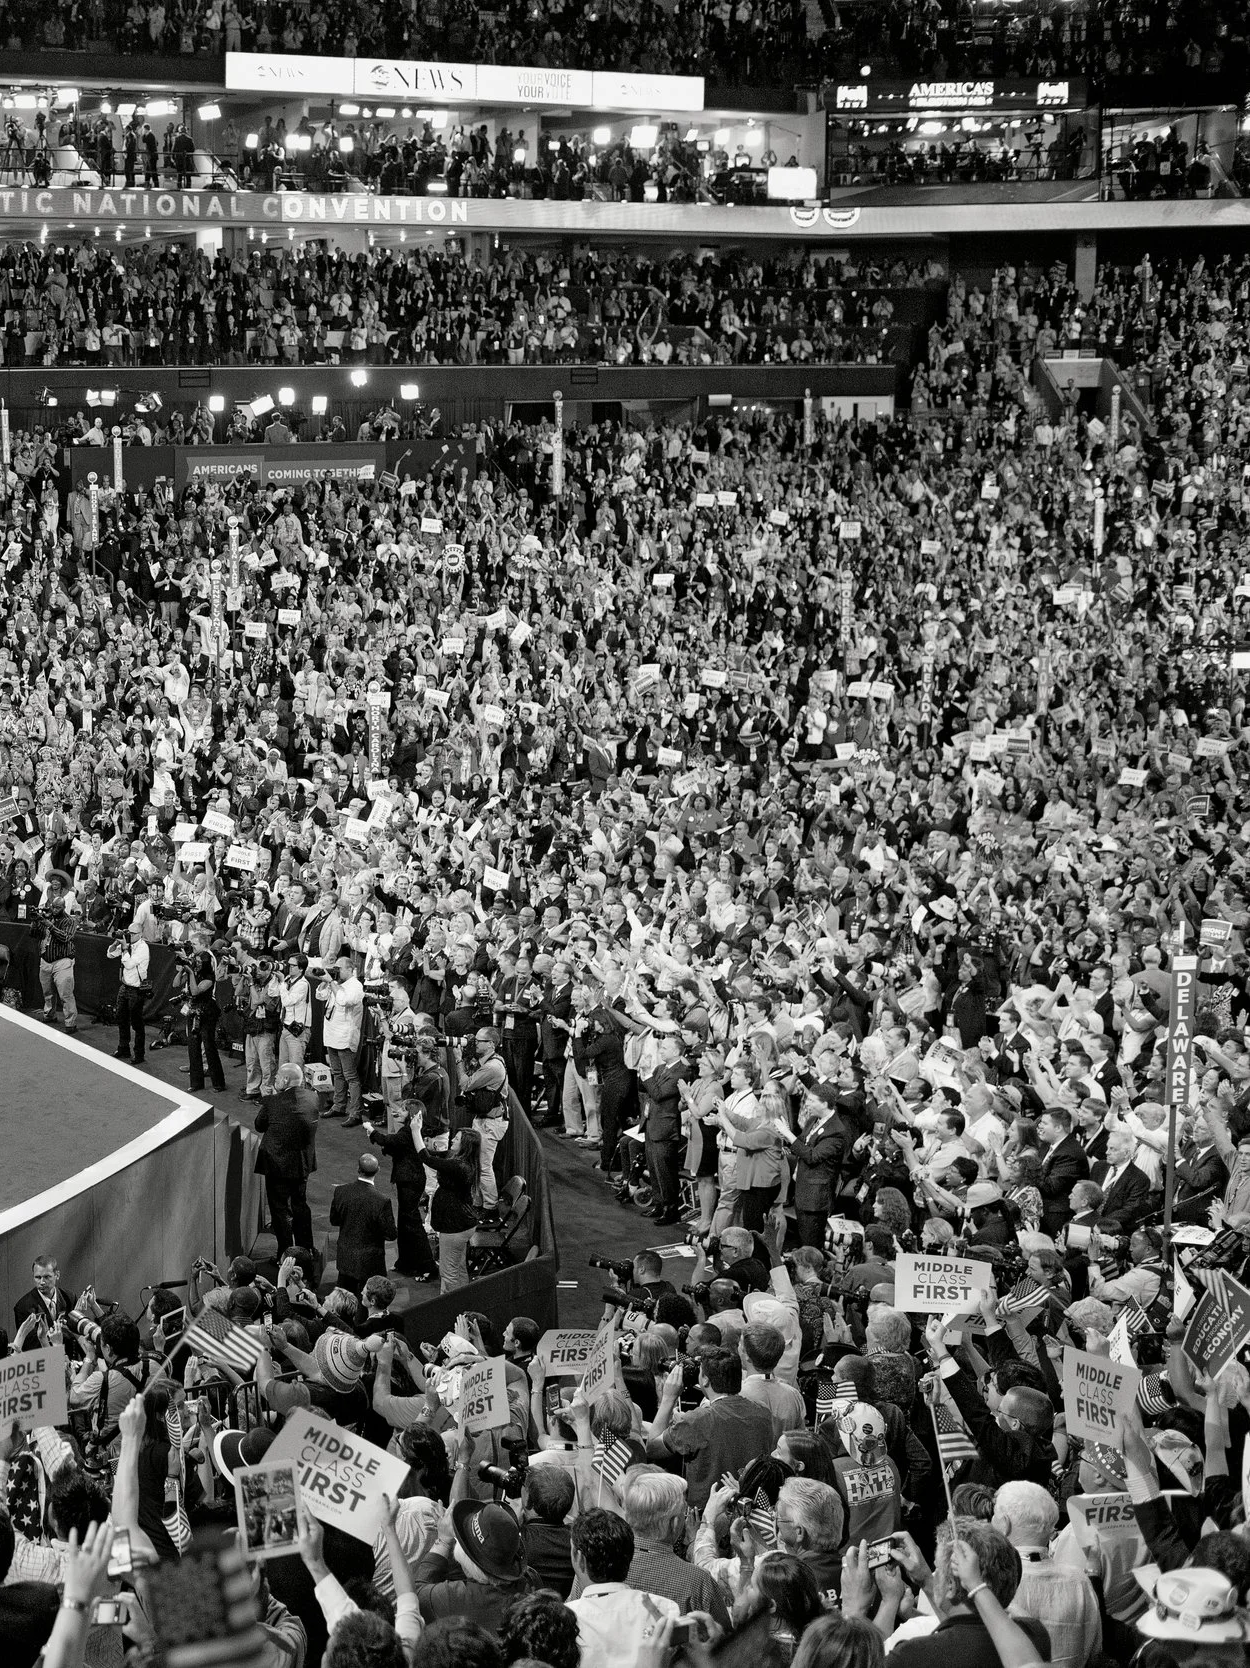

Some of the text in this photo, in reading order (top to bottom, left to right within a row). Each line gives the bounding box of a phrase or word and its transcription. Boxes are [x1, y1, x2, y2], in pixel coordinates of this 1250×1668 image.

[517, 85, 544, 99] YOUR
[544, 73, 572, 88] VOICE
[908, 82, 994, 97] AMERICA'S
[73, 192, 246, 217] NATIONAL
[263, 196, 469, 223] CONVENTION
[193, 463, 258, 475] AMERICANS
[267, 466, 359, 479] COMING TOGETH
[91, 514, 99, 542] ISLAND
[212, 580, 221, 637] PENNSYLVANIA
[841, 590, 851, 643] OREGON
[921, 663, 933, 723] NEVADA
[1038, 657, 1048, 714] IOWA
[370, 705, 380, 773] NORTH CAROLINA
[208, 819, 228, 830] FIRST
[377, 805, 388, 824] FIRST
[230, 857, 251, 866] FIRST
[487, 878, 503, 888] FIRST
[930, 1043, 941, 1057] MID
[1172, 971, 1192, 1104] DELAWARE
[941, 1048, 954, 1063] FIR
[913, 1261, 974, 1275] MIDDLE
[918, 1272, 967, 1285] CLASS
[913, 1284, 972, 1300] FIRST
[1196, 1301, 1216, 1331] STRONGER
[1205, 1312, 1227, 1342] STRONGER
[1202, 1304, 1245, 1361] ECONOMY
[550, 1347, 593, 1363] FIRS
[463, 1368, 493, 1394] MIDDLE
[583, 1358, 608, 1393] FIRST
[1076, 1362, 1123, 1390] MIDDLE
[1078, 1381, 1114, 1406] CLASS
[461, 1395, 494, 1425] FIRST
[1076, 1397, 1117, 1429] FIRST
[303, 1426, 381, 1476] MIDDLE
[300, 1445, 366, 1489] CLASS
[1085, 1504, 1135, 1526] FIRS
